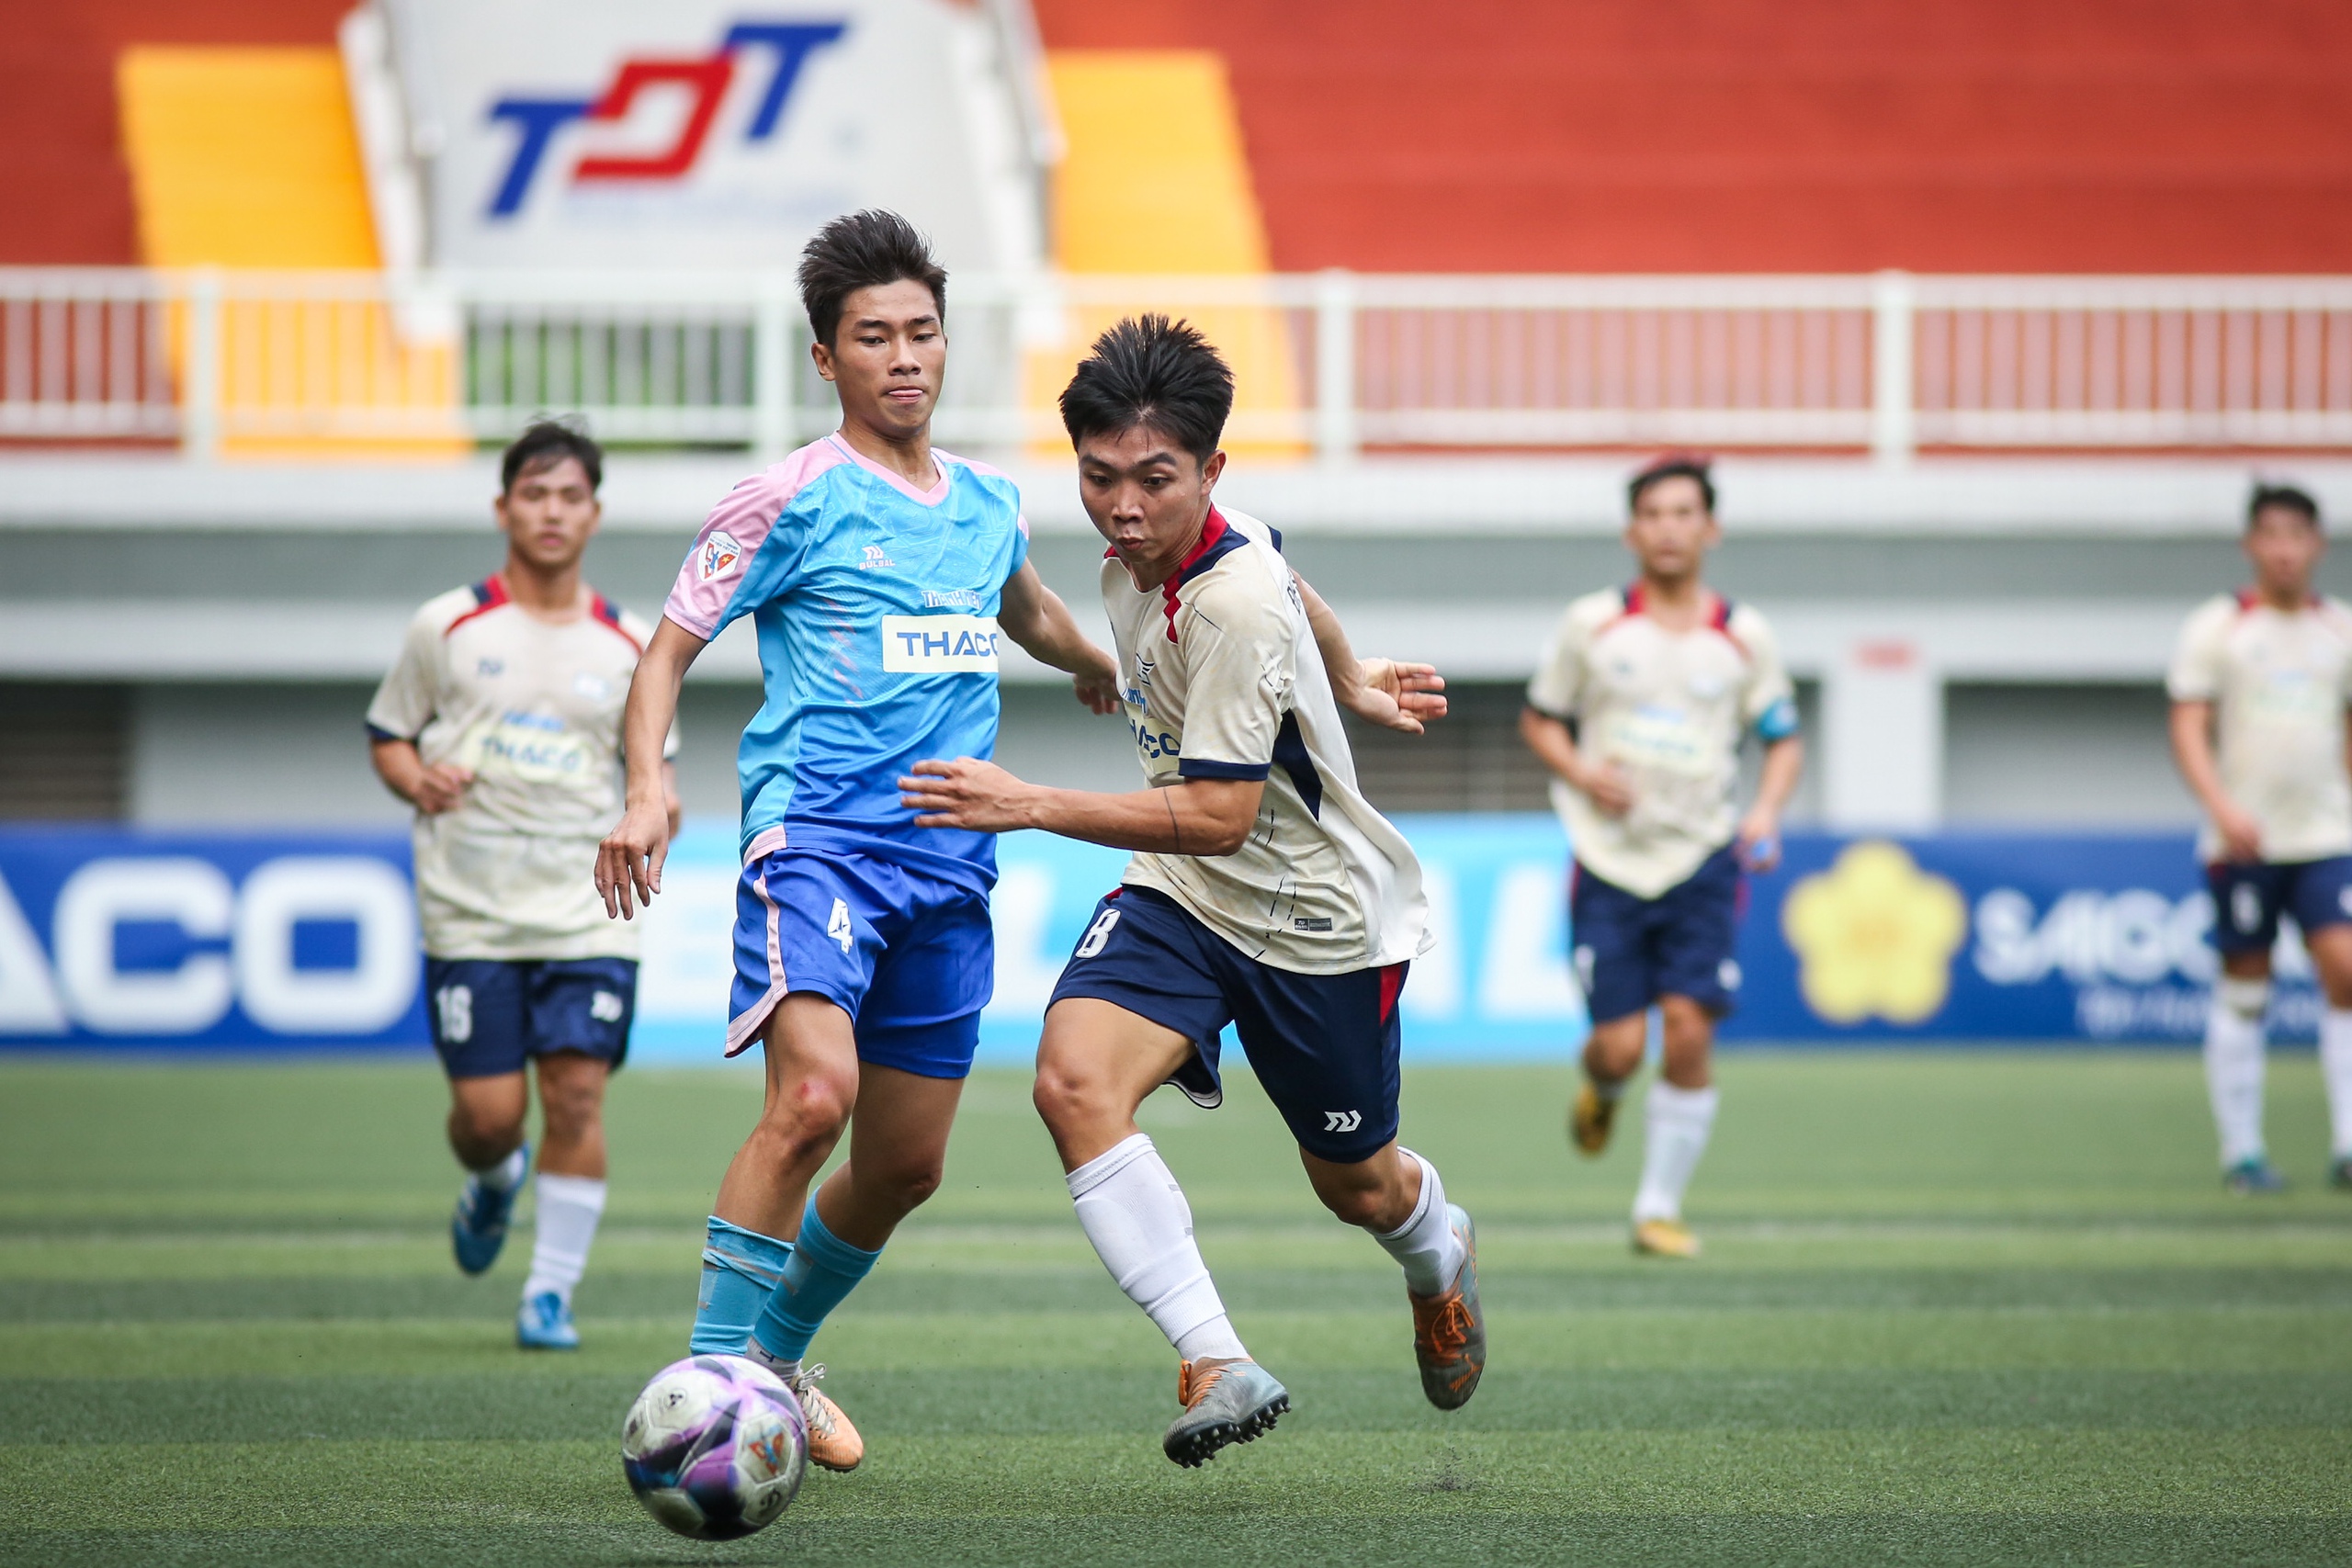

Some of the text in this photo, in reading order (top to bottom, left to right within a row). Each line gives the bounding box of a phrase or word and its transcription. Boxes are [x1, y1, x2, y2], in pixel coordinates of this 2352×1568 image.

[859, 559, 896, 570] BULBAL
[828, 897, 854, 954] 4
[1075, 908, 1121, 959] 8
